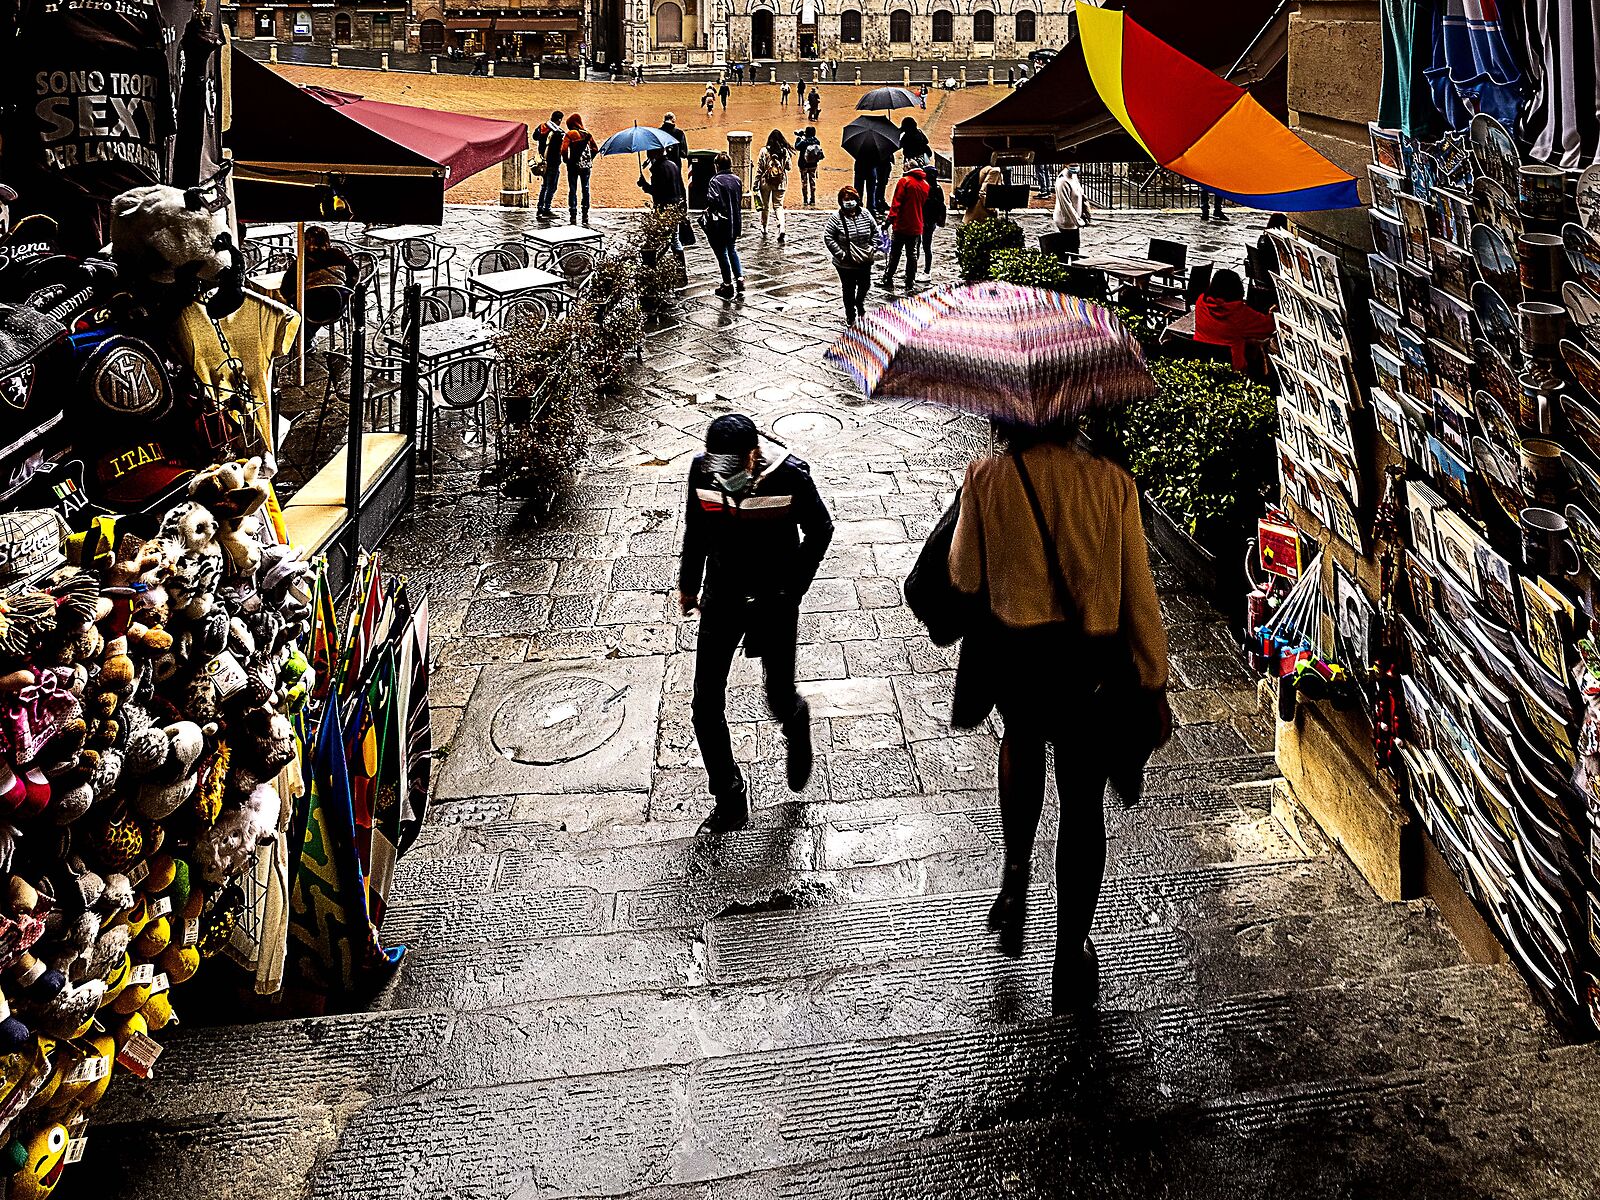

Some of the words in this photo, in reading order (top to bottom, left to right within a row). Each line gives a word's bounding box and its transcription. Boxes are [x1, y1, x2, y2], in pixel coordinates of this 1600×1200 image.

[115, 0, 148, 19] litro
[35, 70, 105, 95] SONO
[35, 94, 156, 144] SEXY
[45, 144, 79, 169] PER
[46, 286, 93, 321] JUVENTUS
